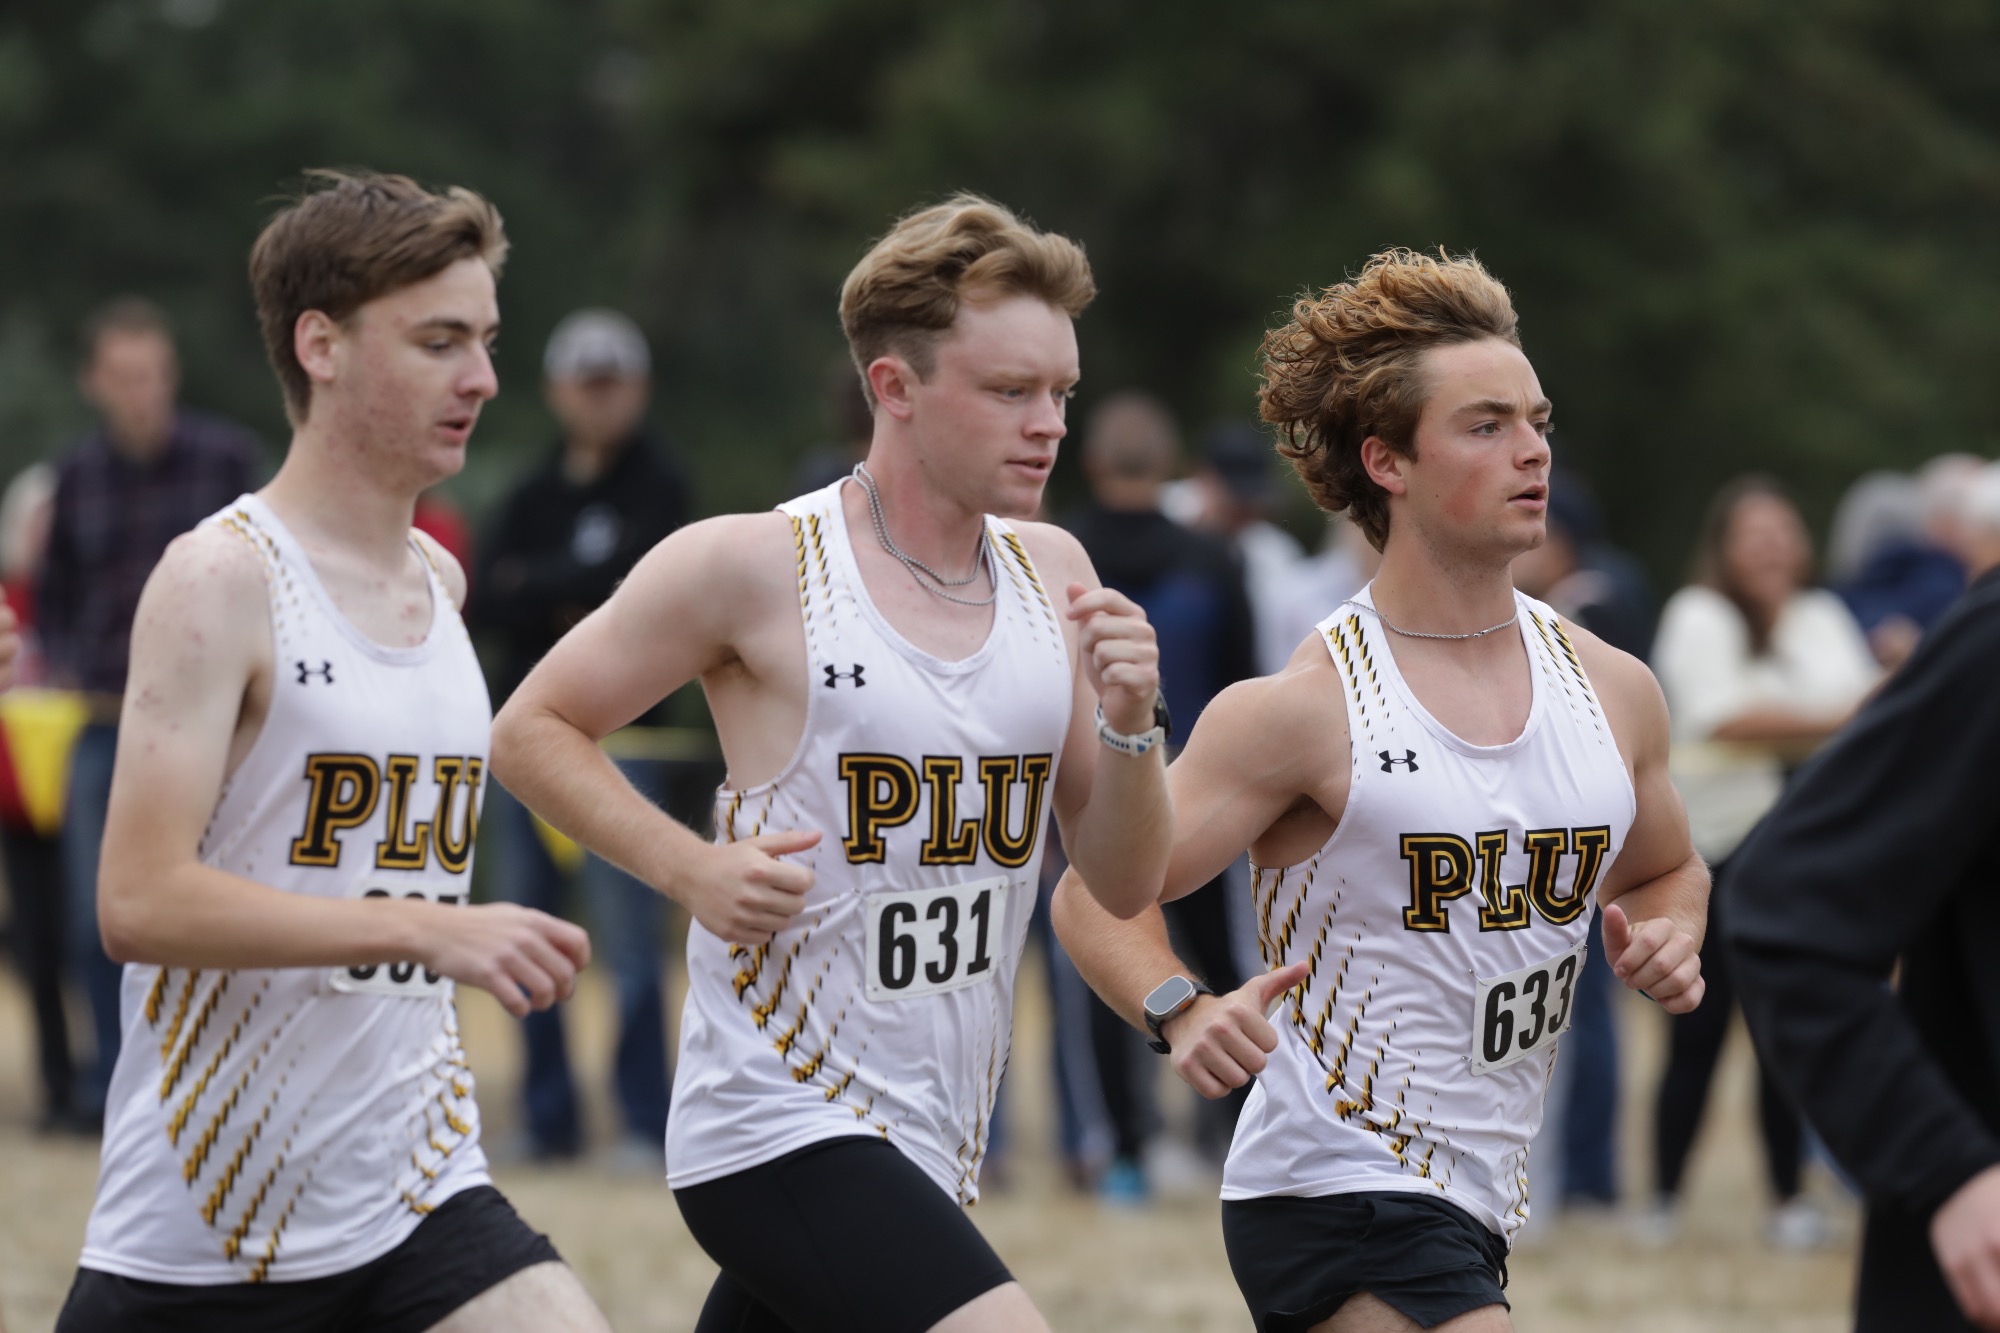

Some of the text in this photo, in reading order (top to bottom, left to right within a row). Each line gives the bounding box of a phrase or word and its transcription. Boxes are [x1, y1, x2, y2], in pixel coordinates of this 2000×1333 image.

[289, 752, 483, 874] PLU
[838, 752, 1053, 868] PLU
[1399, 825, 1610, 933] PLU
[878, 889, 992, 990] 631
[1482, 954, 1577, 1063] 633
